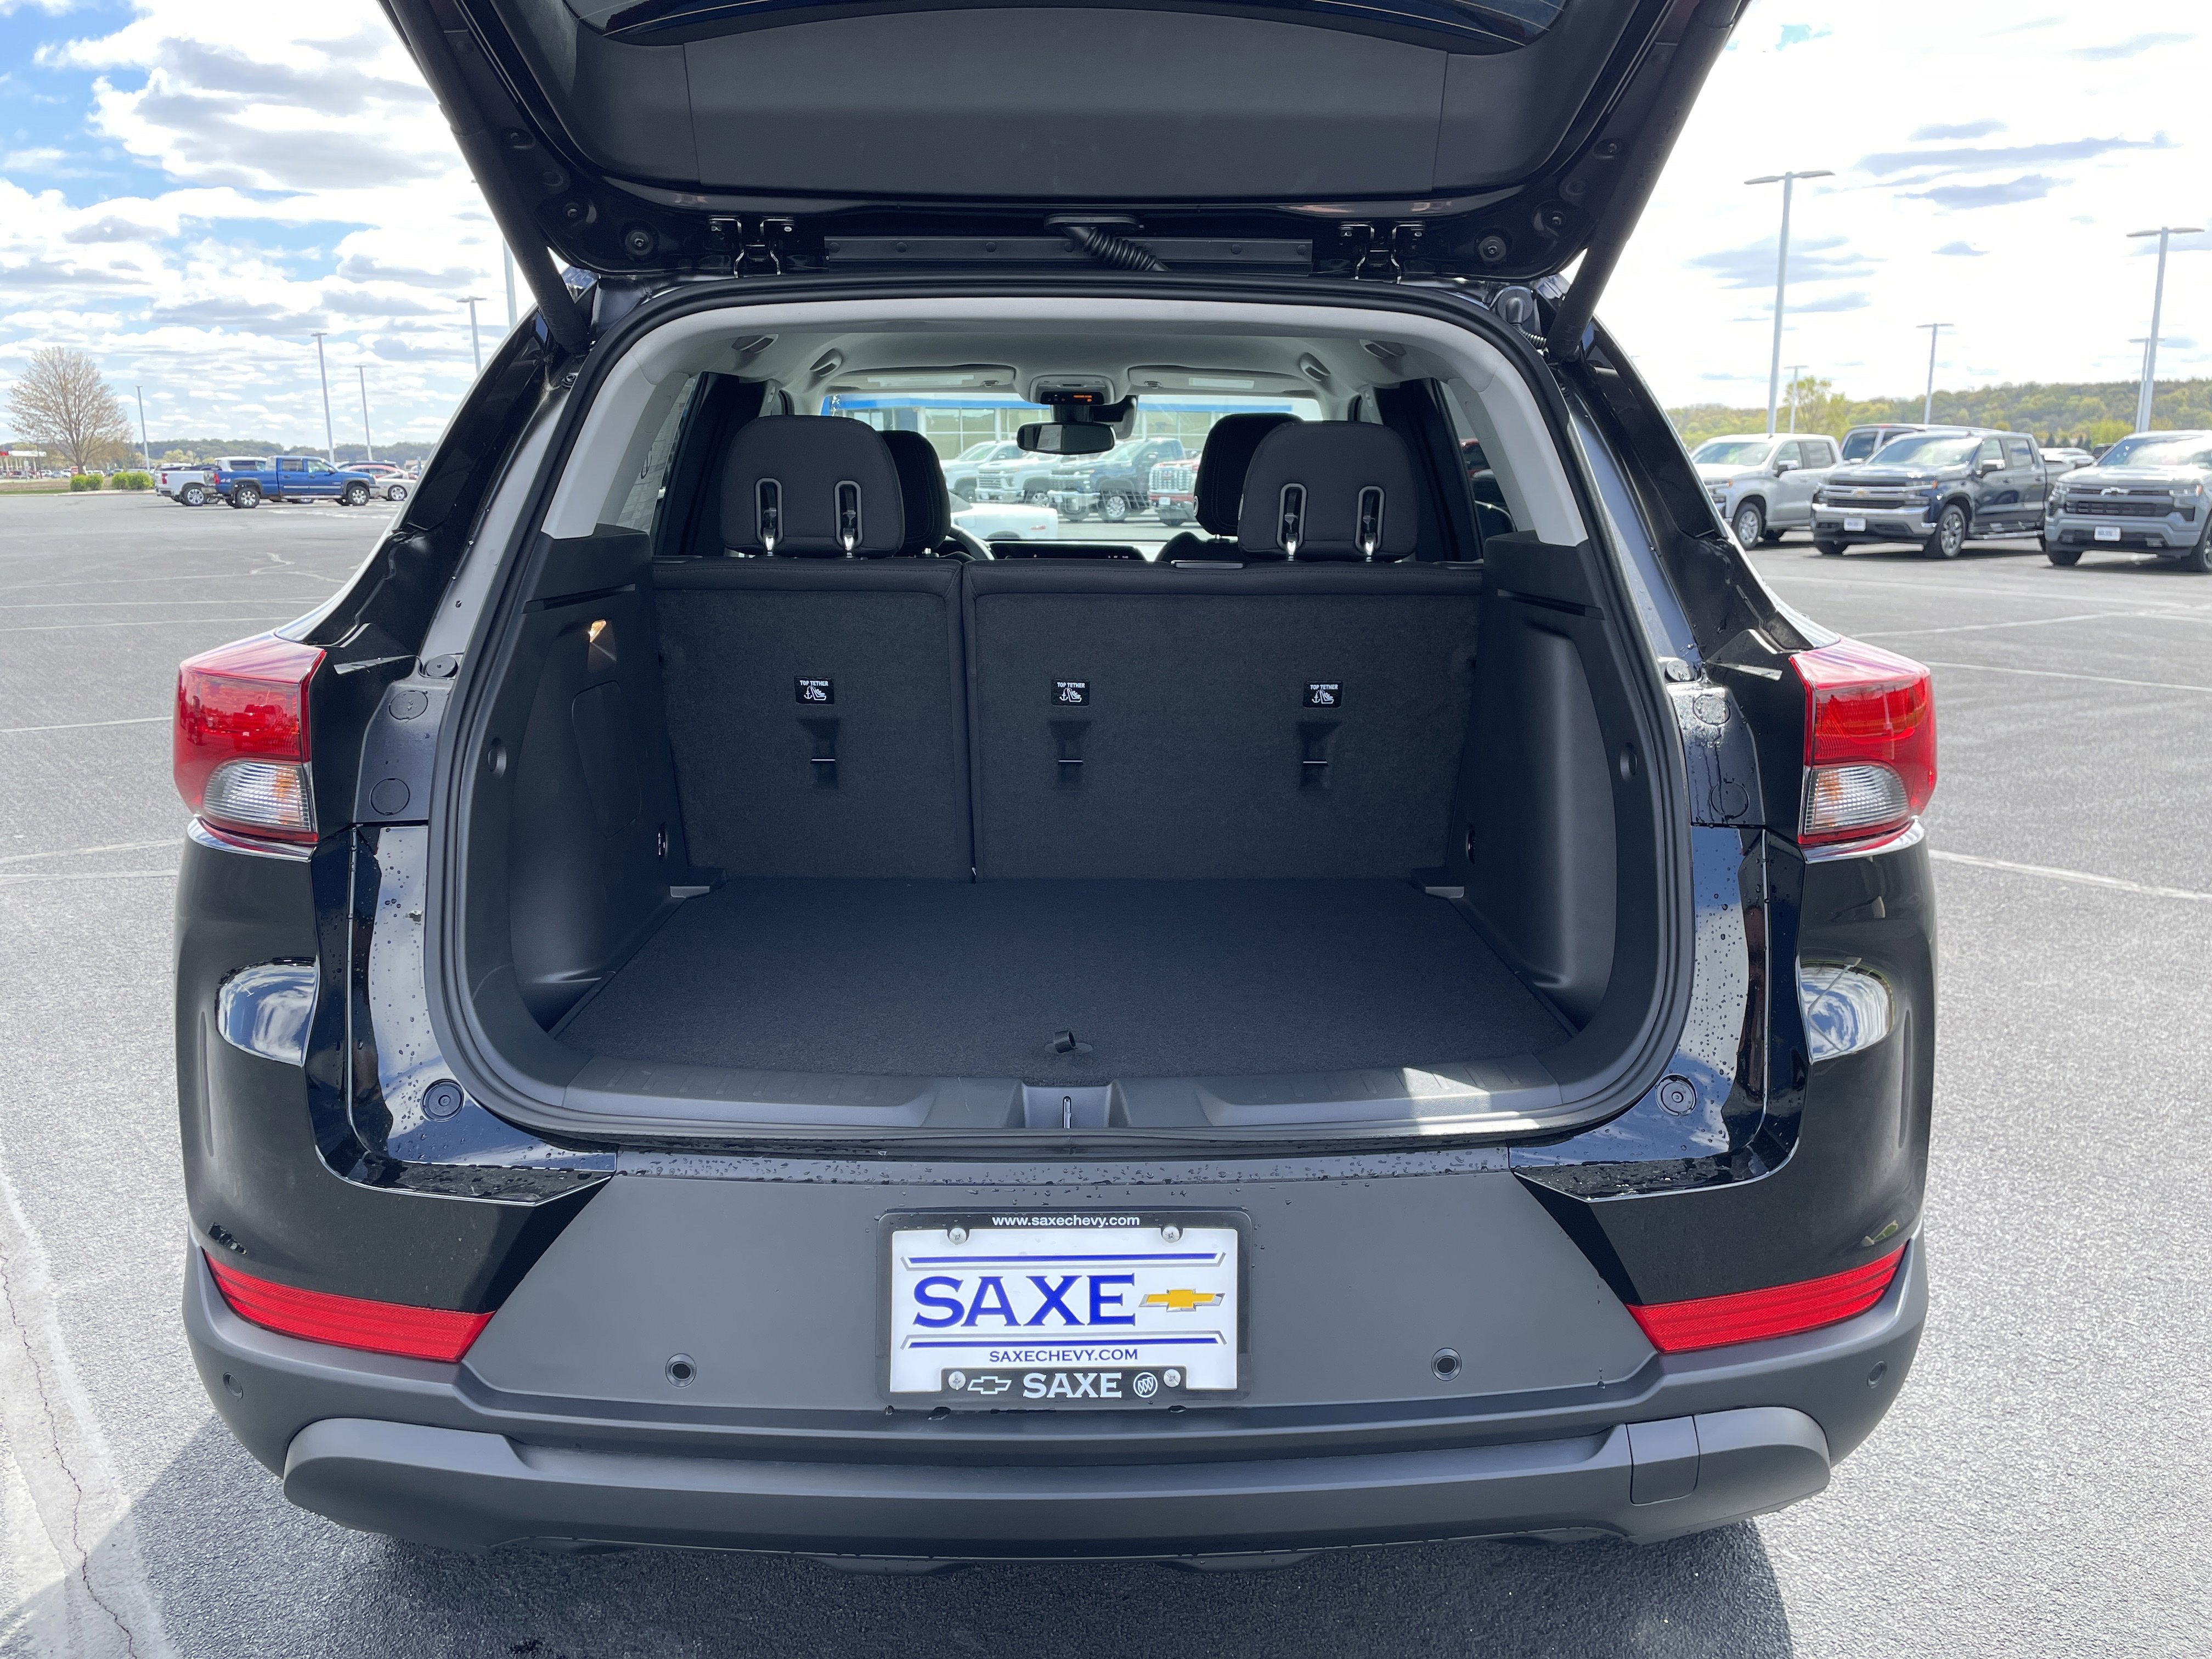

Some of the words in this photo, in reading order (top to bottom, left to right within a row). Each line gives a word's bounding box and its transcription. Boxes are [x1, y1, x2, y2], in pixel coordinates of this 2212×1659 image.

[991, 1214, 1140, 1228] www.saxechevy.com
[912, 1272, 1136, 1328] SAXE
[989, 1348, 1138, 1362] SAXECHEVY.COM
[1022, 1372, 1122, 1399] SAXE
